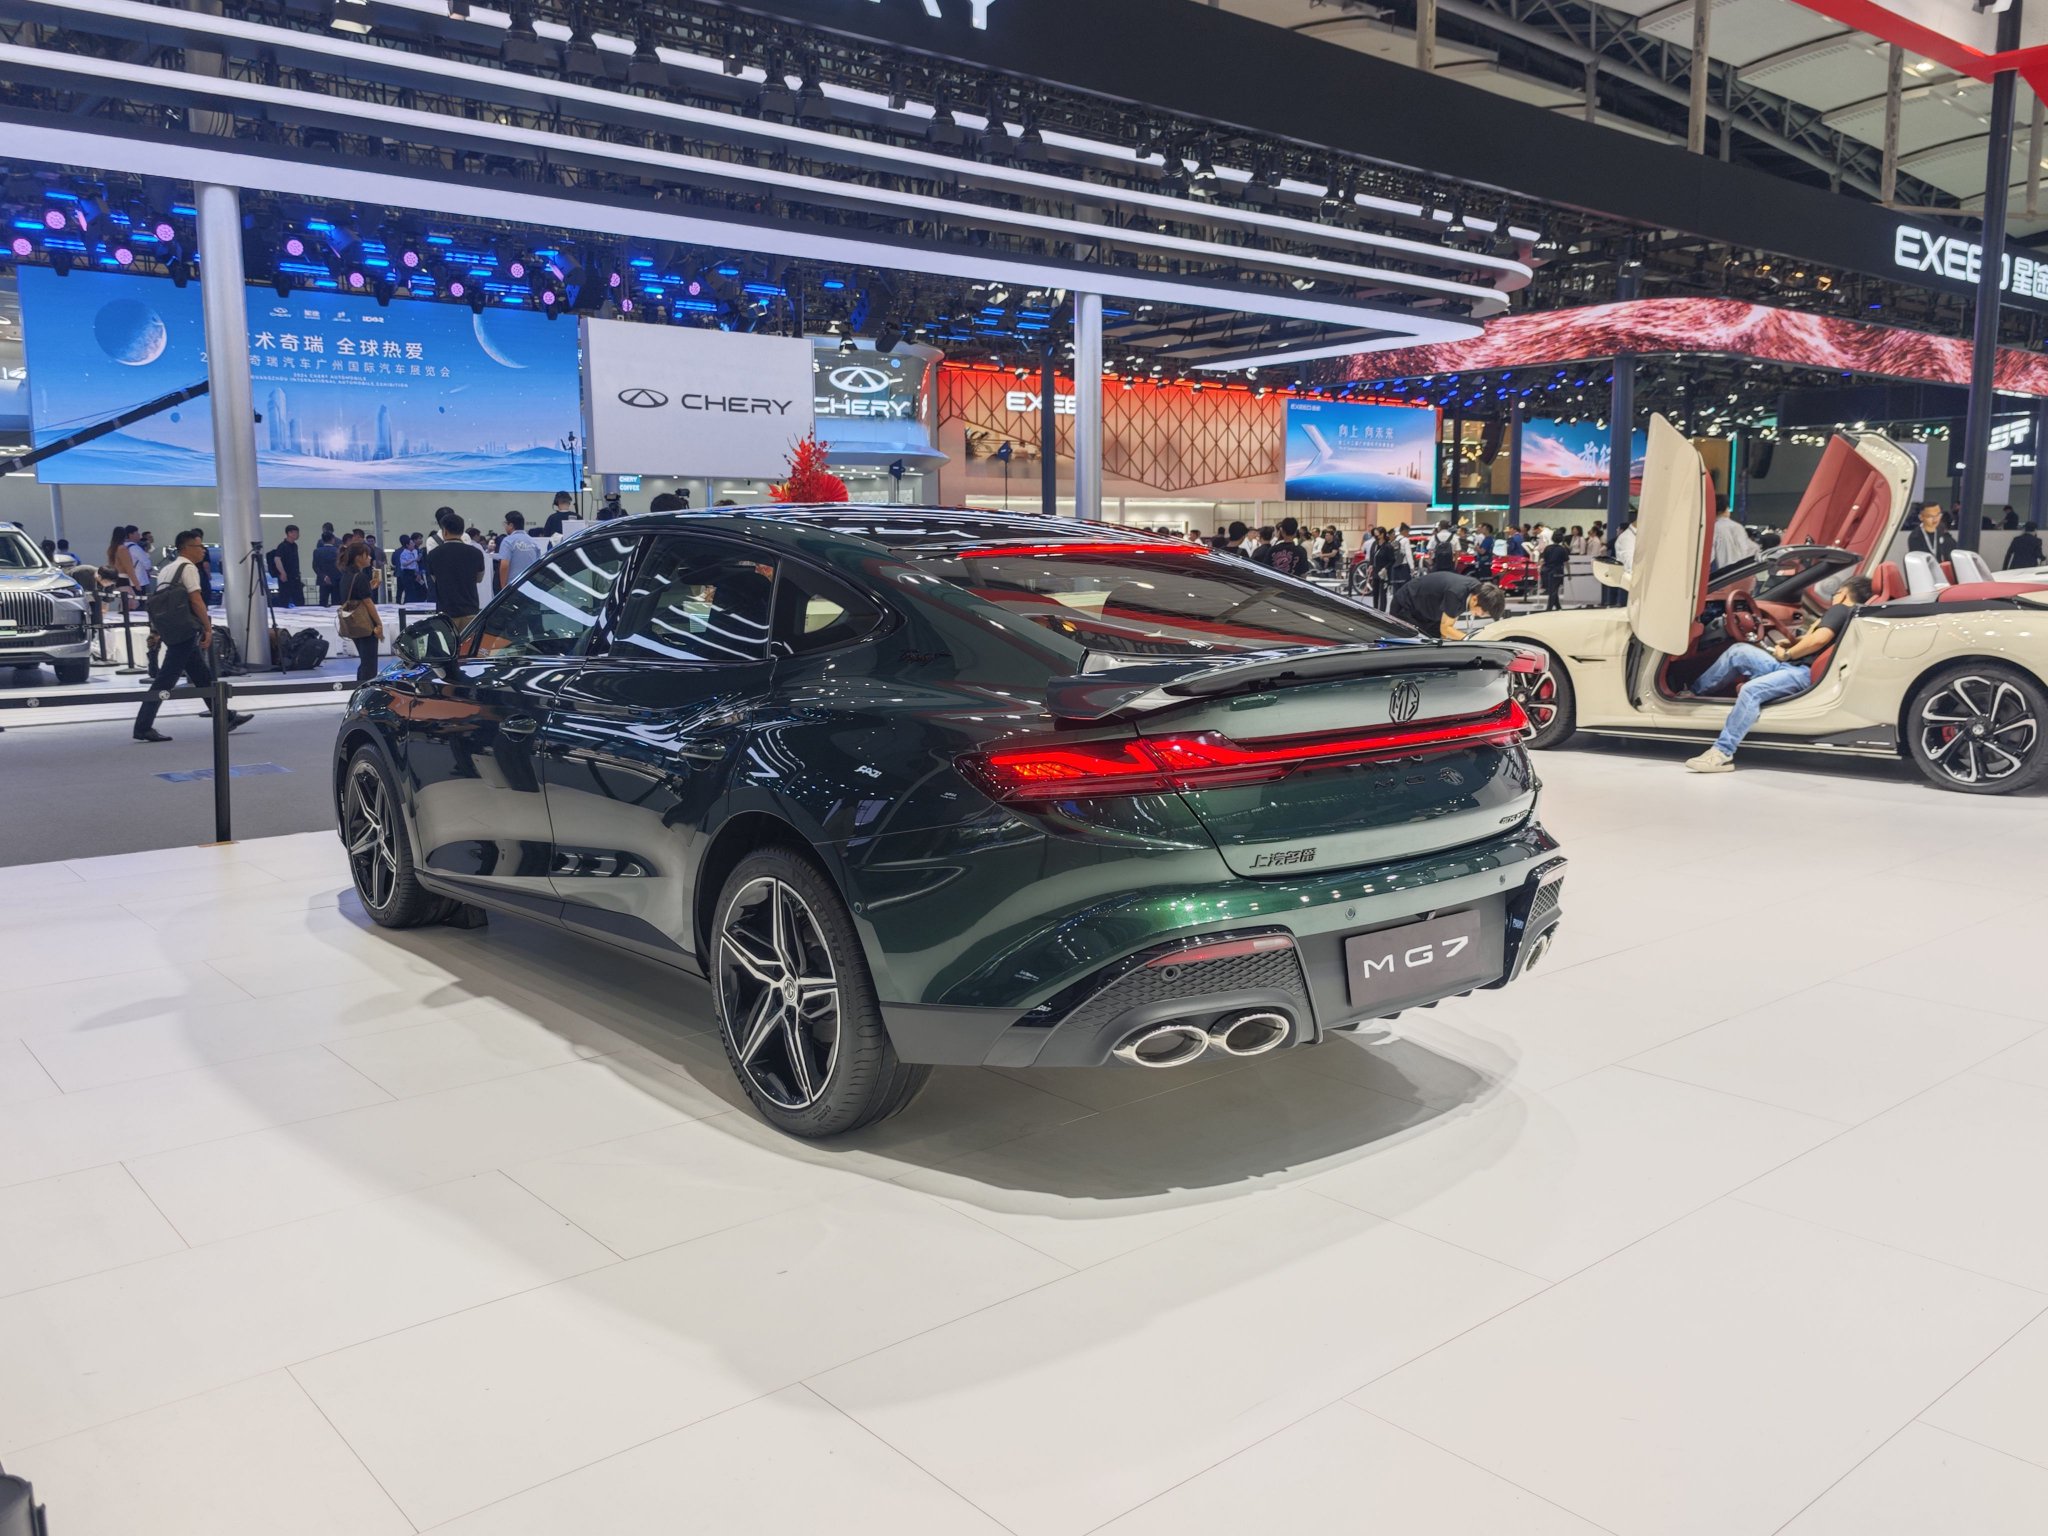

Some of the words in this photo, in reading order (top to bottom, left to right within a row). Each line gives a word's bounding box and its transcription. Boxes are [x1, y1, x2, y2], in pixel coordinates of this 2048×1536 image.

[1895, 225, 2010, 290] EXEE
[247, 331, 324, 354] 术奇瑞
[336, 337, 424, 360] 全球热爱
[681, 394, 793, 415] CHERY
[814, 396, 911, 418] CHERY
[1006, 391, 1076, 415] EXEE
[1339, 424, 1358, 438] 向上
[619, 475, 637, 483] CHERY
[1249, 848, 1317, 868] 上汽名爵
[1363, 935, 1469, 979] MG7
